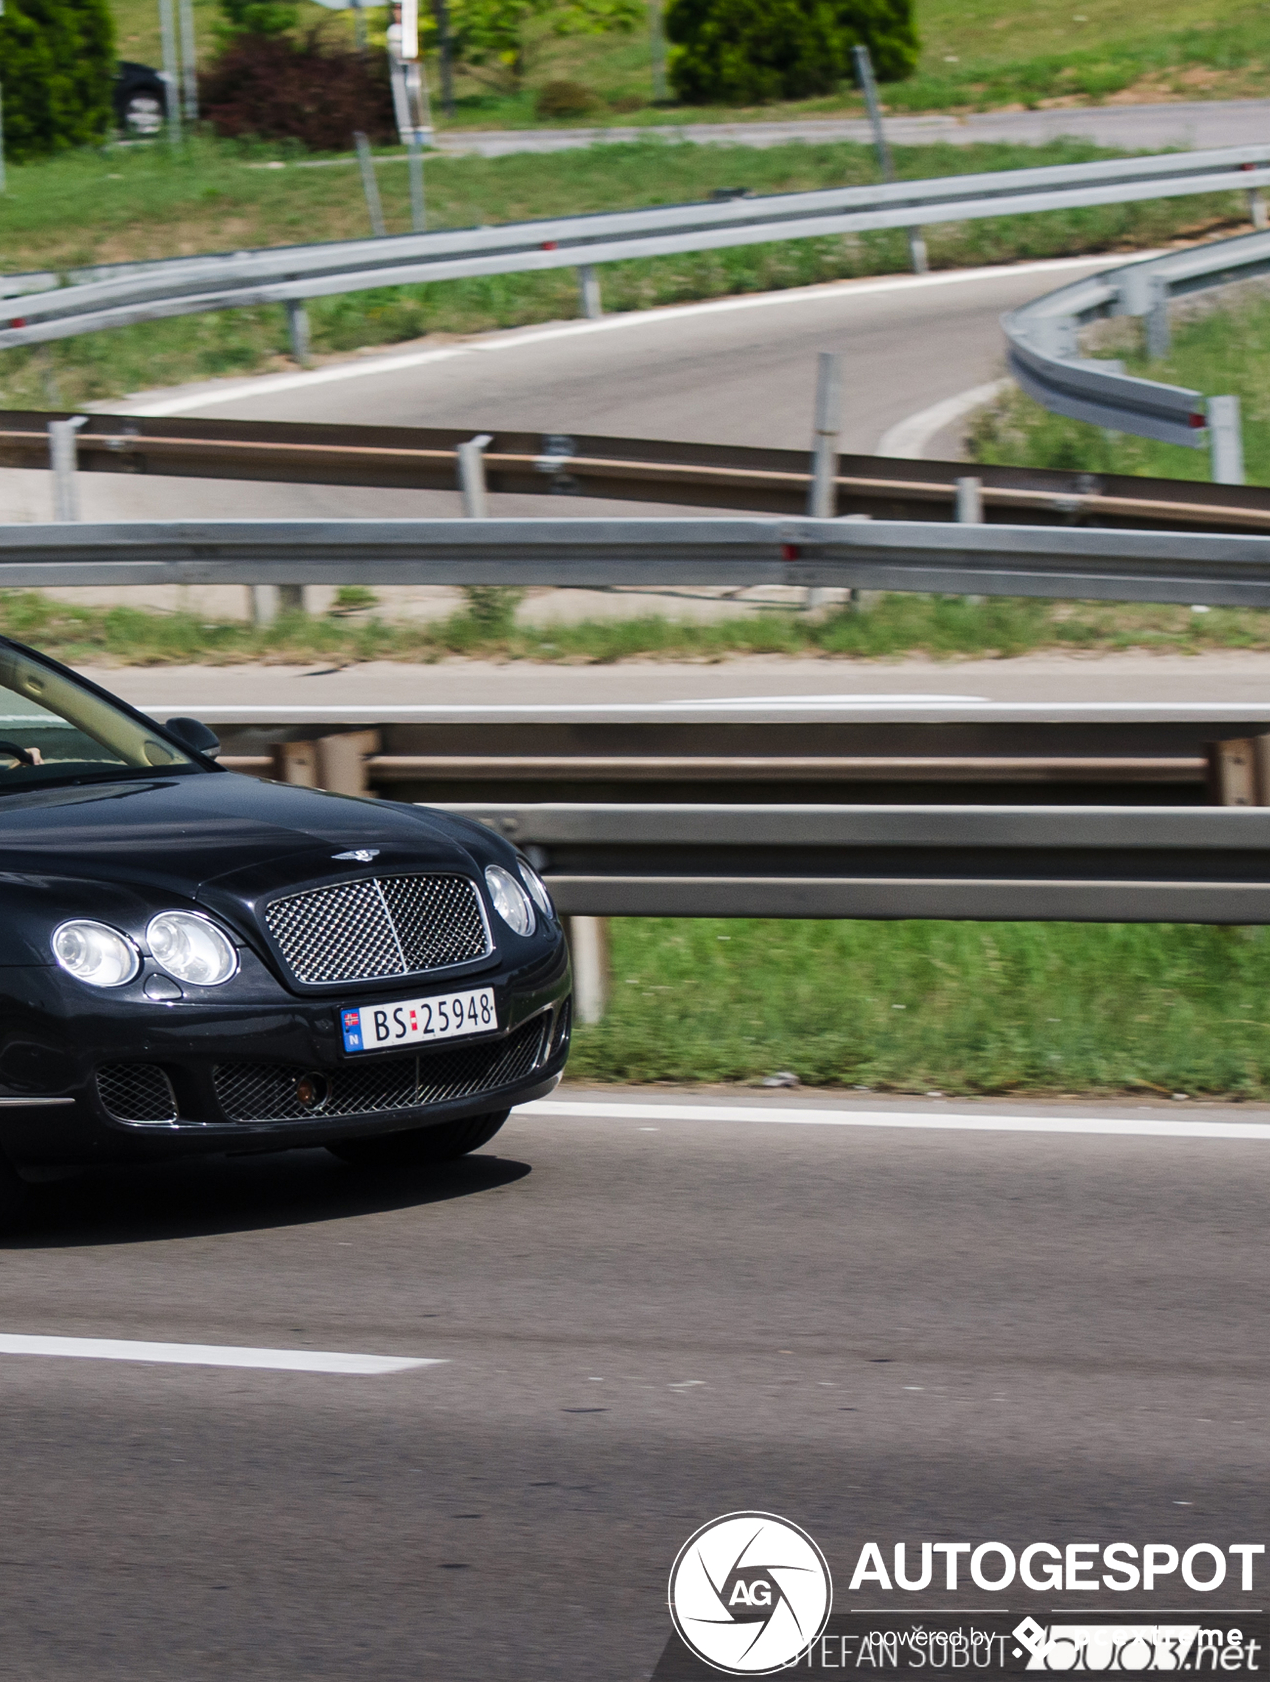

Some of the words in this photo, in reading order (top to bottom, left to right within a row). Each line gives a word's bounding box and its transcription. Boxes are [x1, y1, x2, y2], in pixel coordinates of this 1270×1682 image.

[373, 1007, 407, 1041] BS
[420, 993, 492, 1034] 25948
[348, 1034, 359, 1045] N
